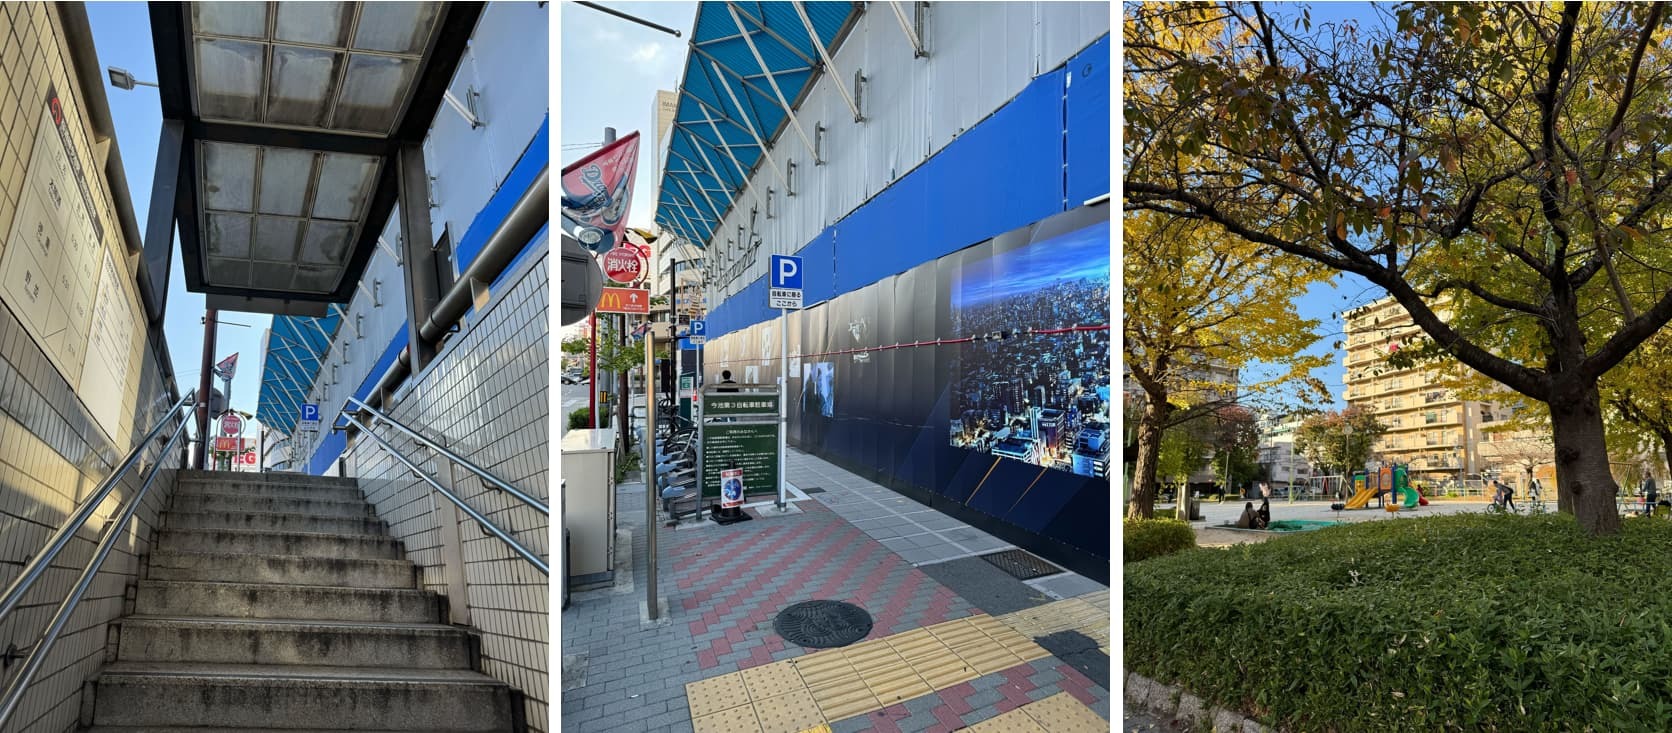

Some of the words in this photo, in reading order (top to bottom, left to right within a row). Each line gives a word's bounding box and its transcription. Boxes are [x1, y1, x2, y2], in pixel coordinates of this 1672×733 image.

[607, 257, 638, 273] 消火栓
[779, 258, 798, 285] P
[693, 321, 704, 335] P
[305, 405, 316, 419] P
